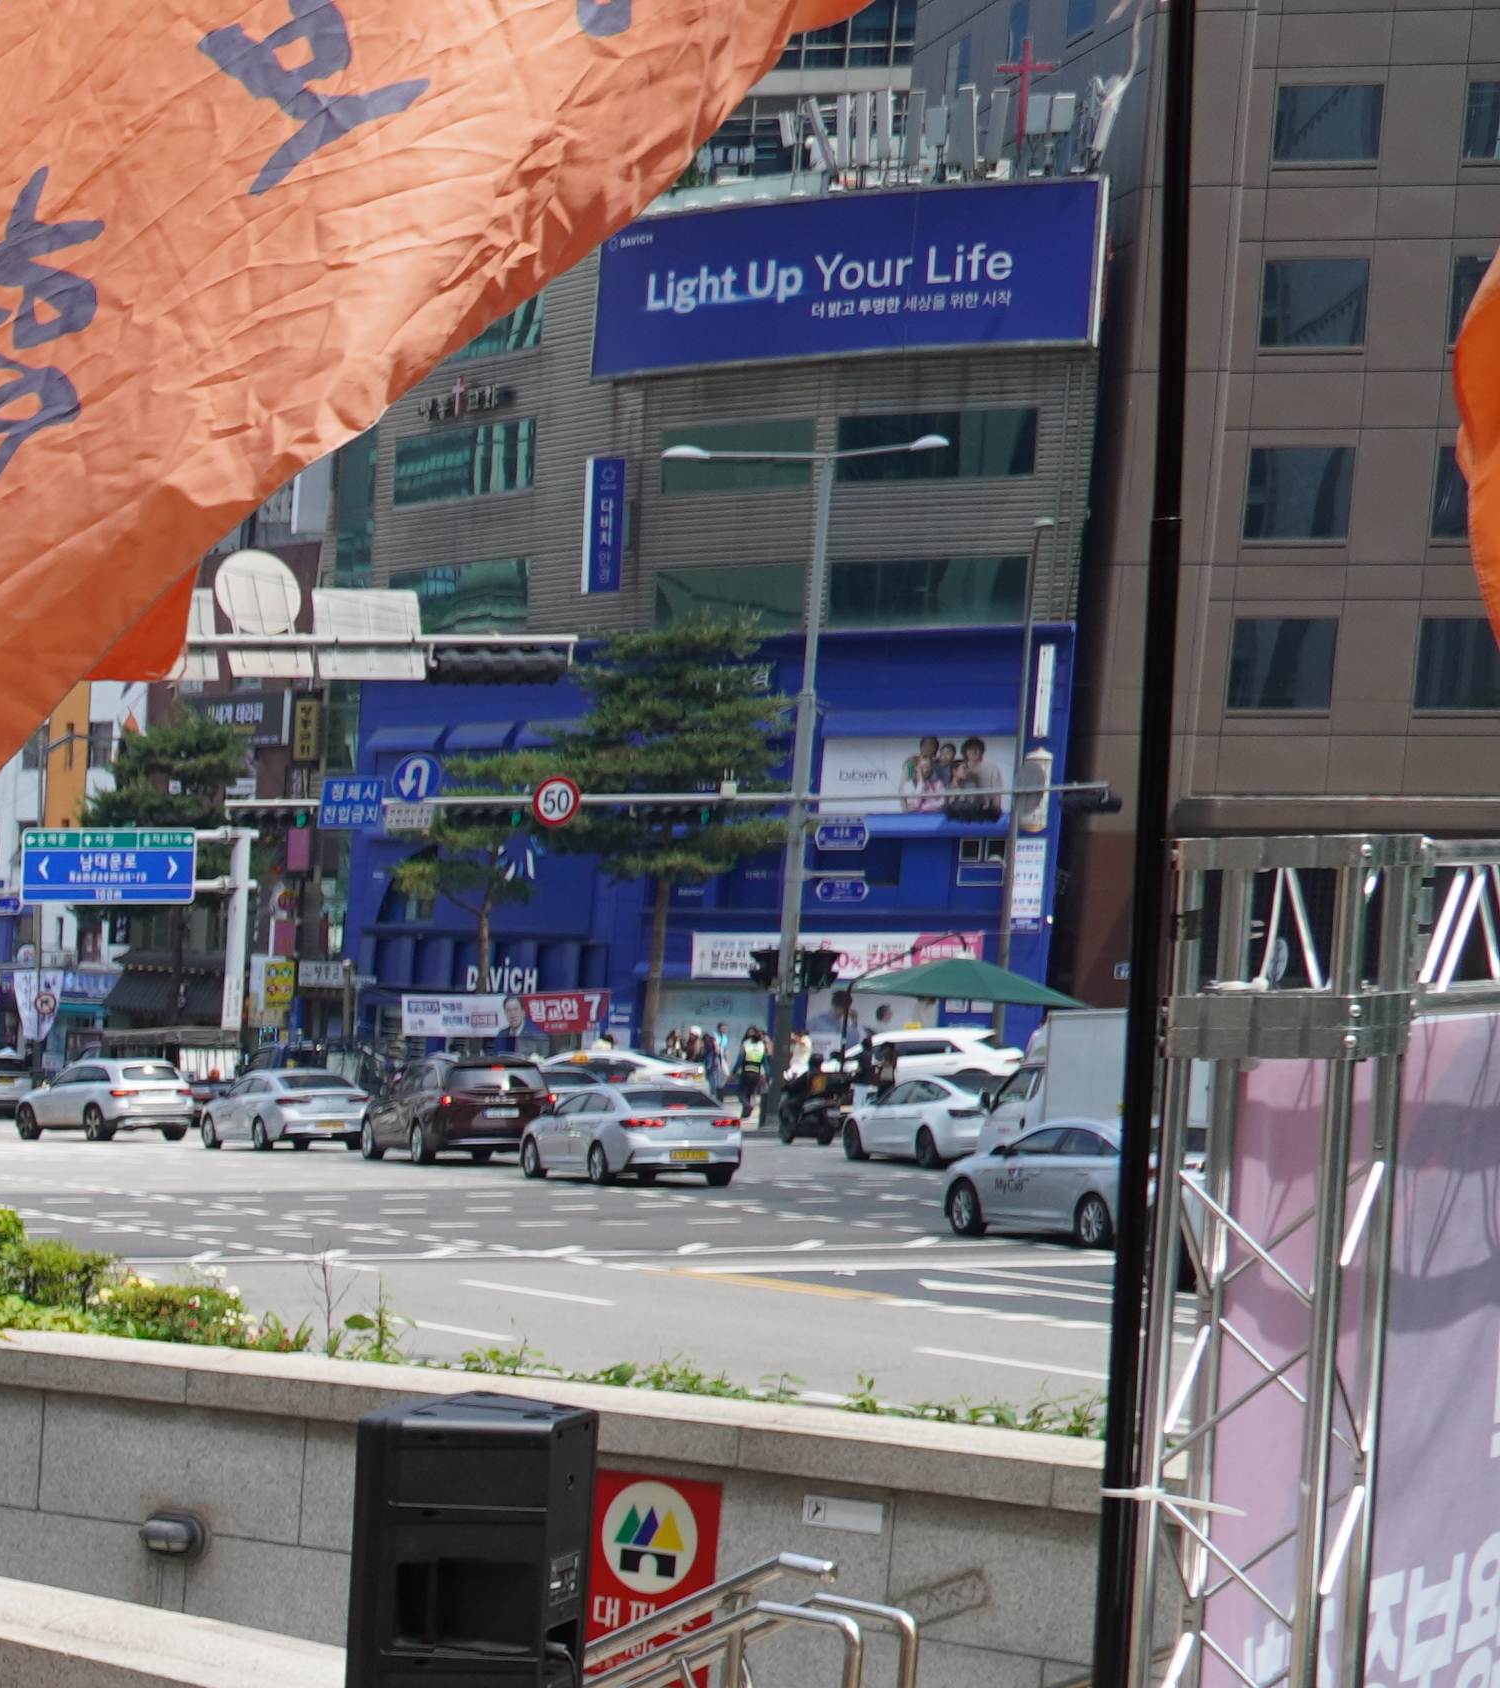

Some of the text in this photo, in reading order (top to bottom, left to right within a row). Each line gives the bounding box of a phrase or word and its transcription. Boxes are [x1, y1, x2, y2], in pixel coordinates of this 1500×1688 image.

[646, 243, 1012, 314] Light Up Your Life
[811, 290, 1011, 318] 더 밝고 투명한 세상을 위한 시작
[331, 782, 378, 801] 정체시
[543, 790, 570, 813] 50
[323, 805, 379, 824] 진입금지
[80, 853, 137, 872] 남대문로
[529, 995, 601, 1021] 황교안 7
